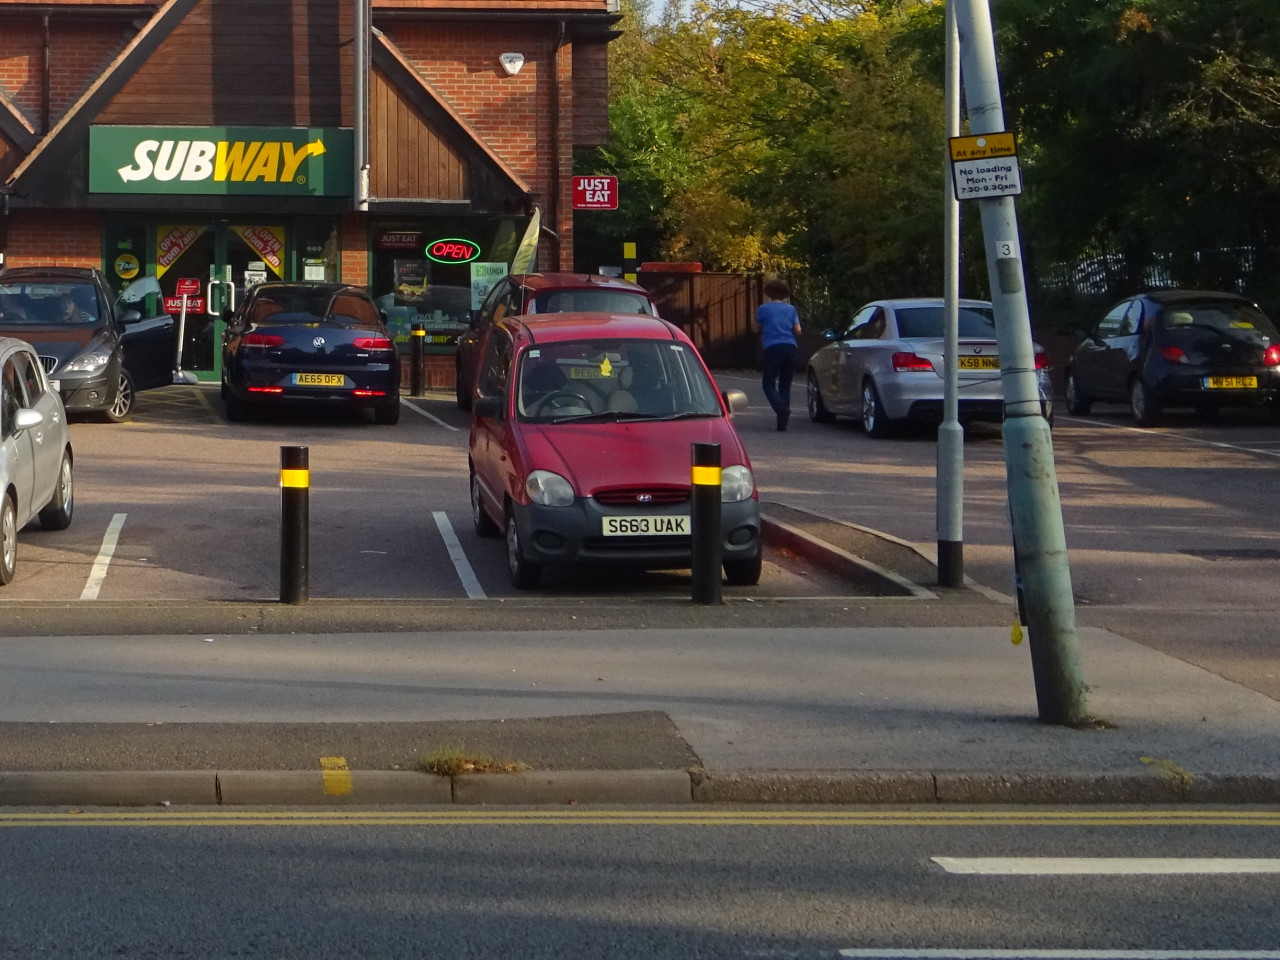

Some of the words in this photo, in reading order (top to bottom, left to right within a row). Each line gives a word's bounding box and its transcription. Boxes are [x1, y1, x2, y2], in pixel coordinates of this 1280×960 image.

[990, 146, 1012, 154] time
[118, 138, 327, 183] SUBWAY
[977, 165, 1012, 174] loading
[577, 178, 610, 190] JUST
[995, 174, 1008, 182] Fri
[585, 190, 611, 202] EAT
[160, 227, 182, 251] OPEN
[260, 229, 281, 251] OPEN
[381, 234, 401, 242] JUST
[402, 234, 417, 242] EAT
[244, 228, 263, 250] from
[262, 247, 280, 267] 7am
[432, 242, 474, 259] OPEN
[1002, 244, 1011, 256] 3
[159, 246, 180, 266] from
[166, 299, 183, 307] JUS
[187, 299, 202, 307] EAT
[298, 374, 322, 383] AE65
[324, 375, 342, 384] OFX
[608, 518, 650, 533] S663
[654, 518, 685, 532] UAK
